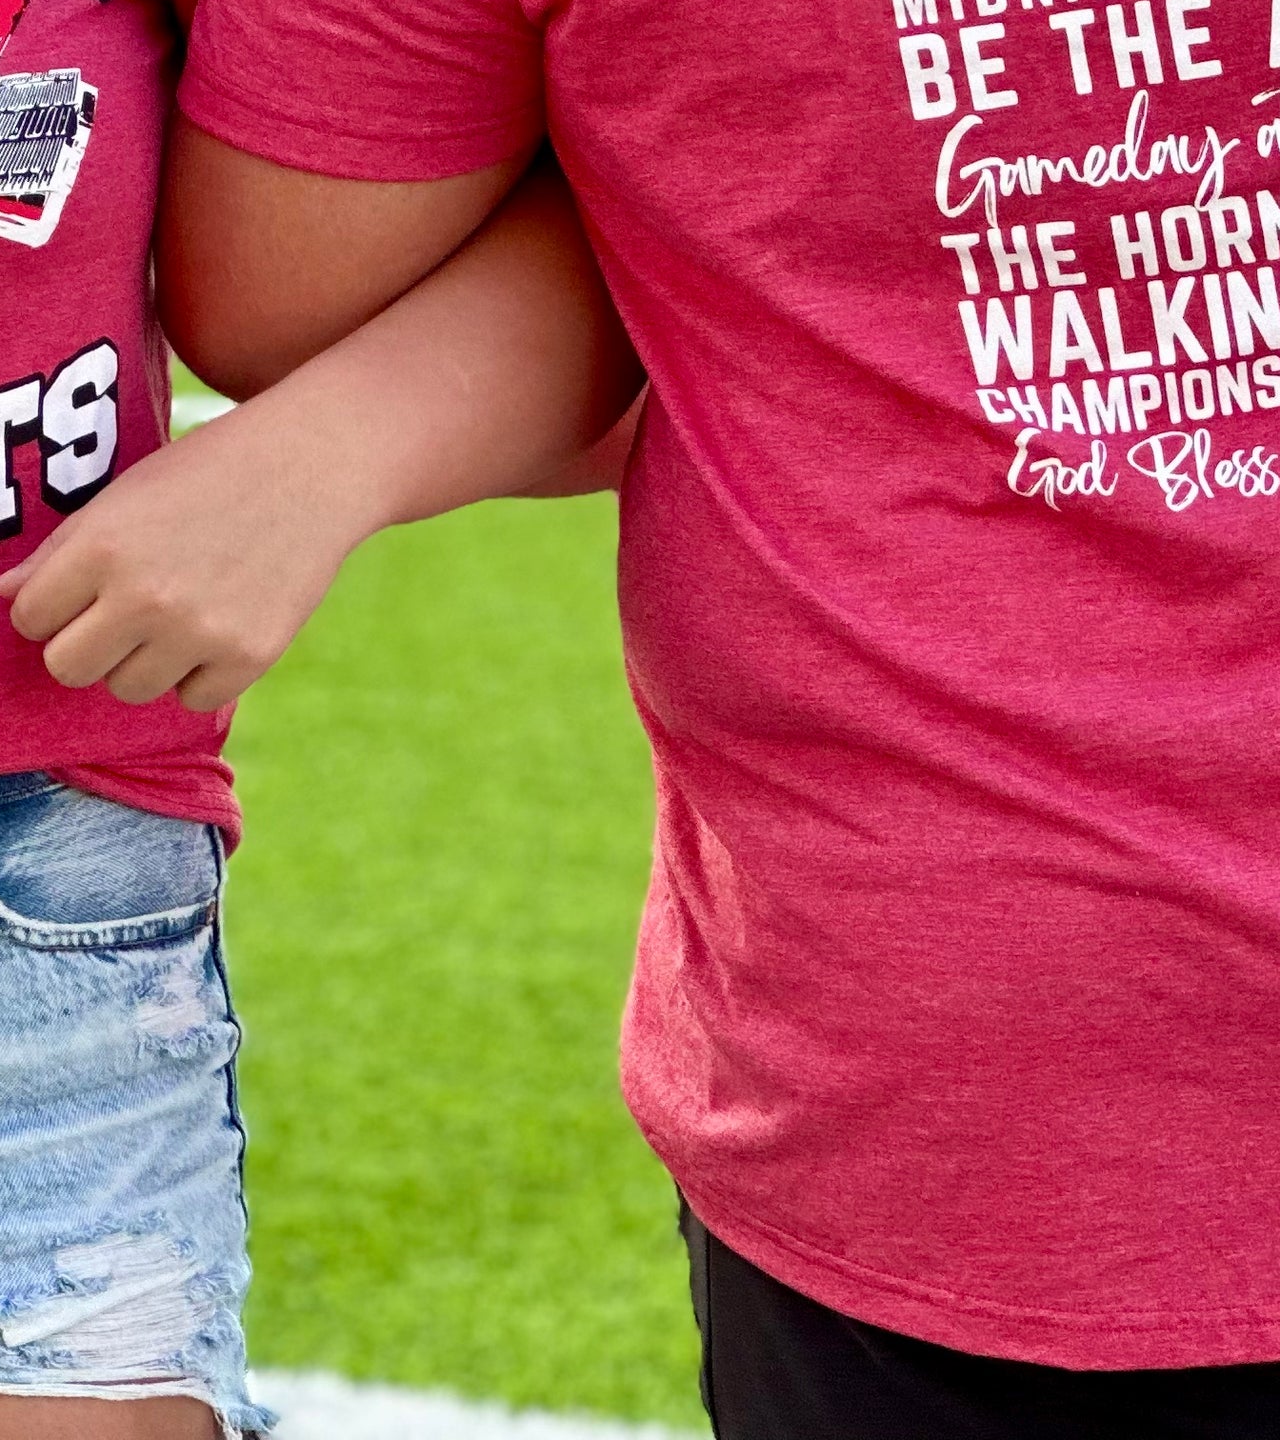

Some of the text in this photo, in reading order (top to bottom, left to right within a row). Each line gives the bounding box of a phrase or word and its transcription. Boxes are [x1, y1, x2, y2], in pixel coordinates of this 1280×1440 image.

[898, 23, 1018, 120] BE
[934, 92, 1241, 229] Gameday
[940, 221, 1087, 295] THE
[1007, 427, 1119, 512] God
[1126, 428, 1280, 512] Bless
